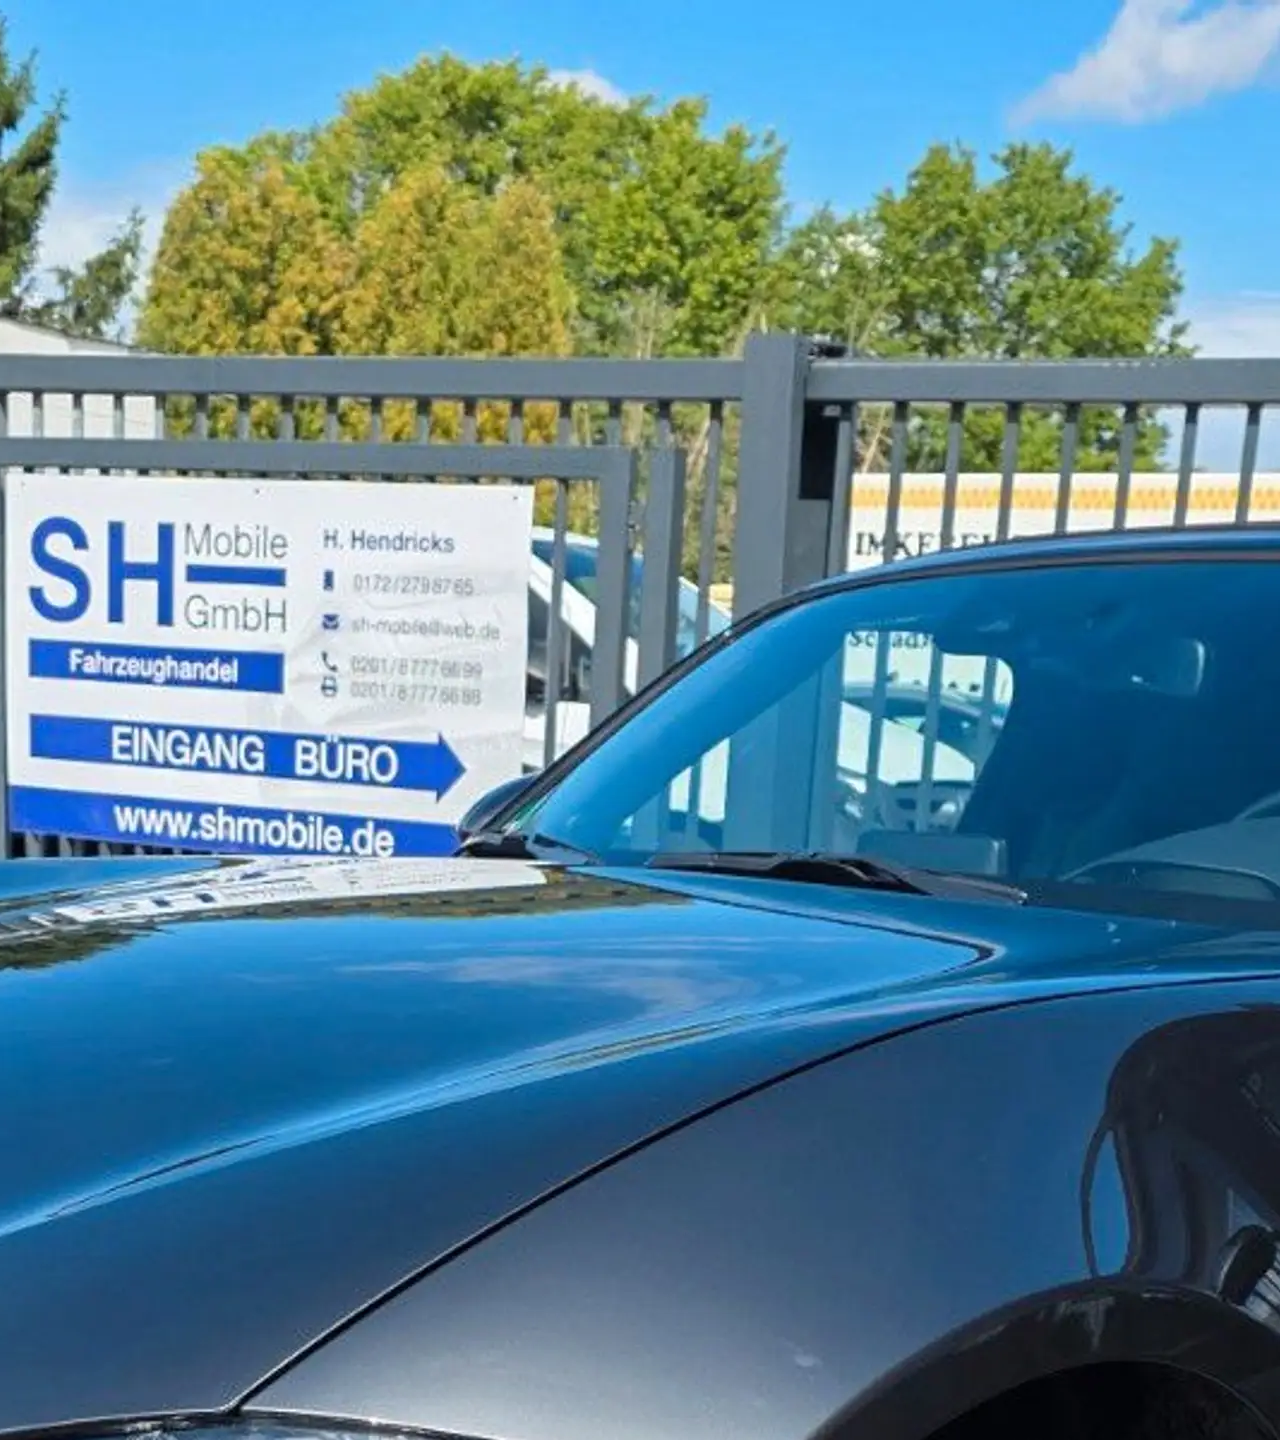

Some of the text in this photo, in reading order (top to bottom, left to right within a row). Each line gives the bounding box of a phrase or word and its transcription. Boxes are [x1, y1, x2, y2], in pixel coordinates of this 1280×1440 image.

[183, 522, 289, 560] Mobile
[322, 529, 456, 553] H. Hendricks
[28, 515, 176, 627] SH
[183, 593, 288, 633] GmbH
[69, 647, 239, 686] Fahrzeughandel
[110, 724, 400, 784] EINGANG BÜRO
[112, 803, 396, 858] www.shmobile.de
